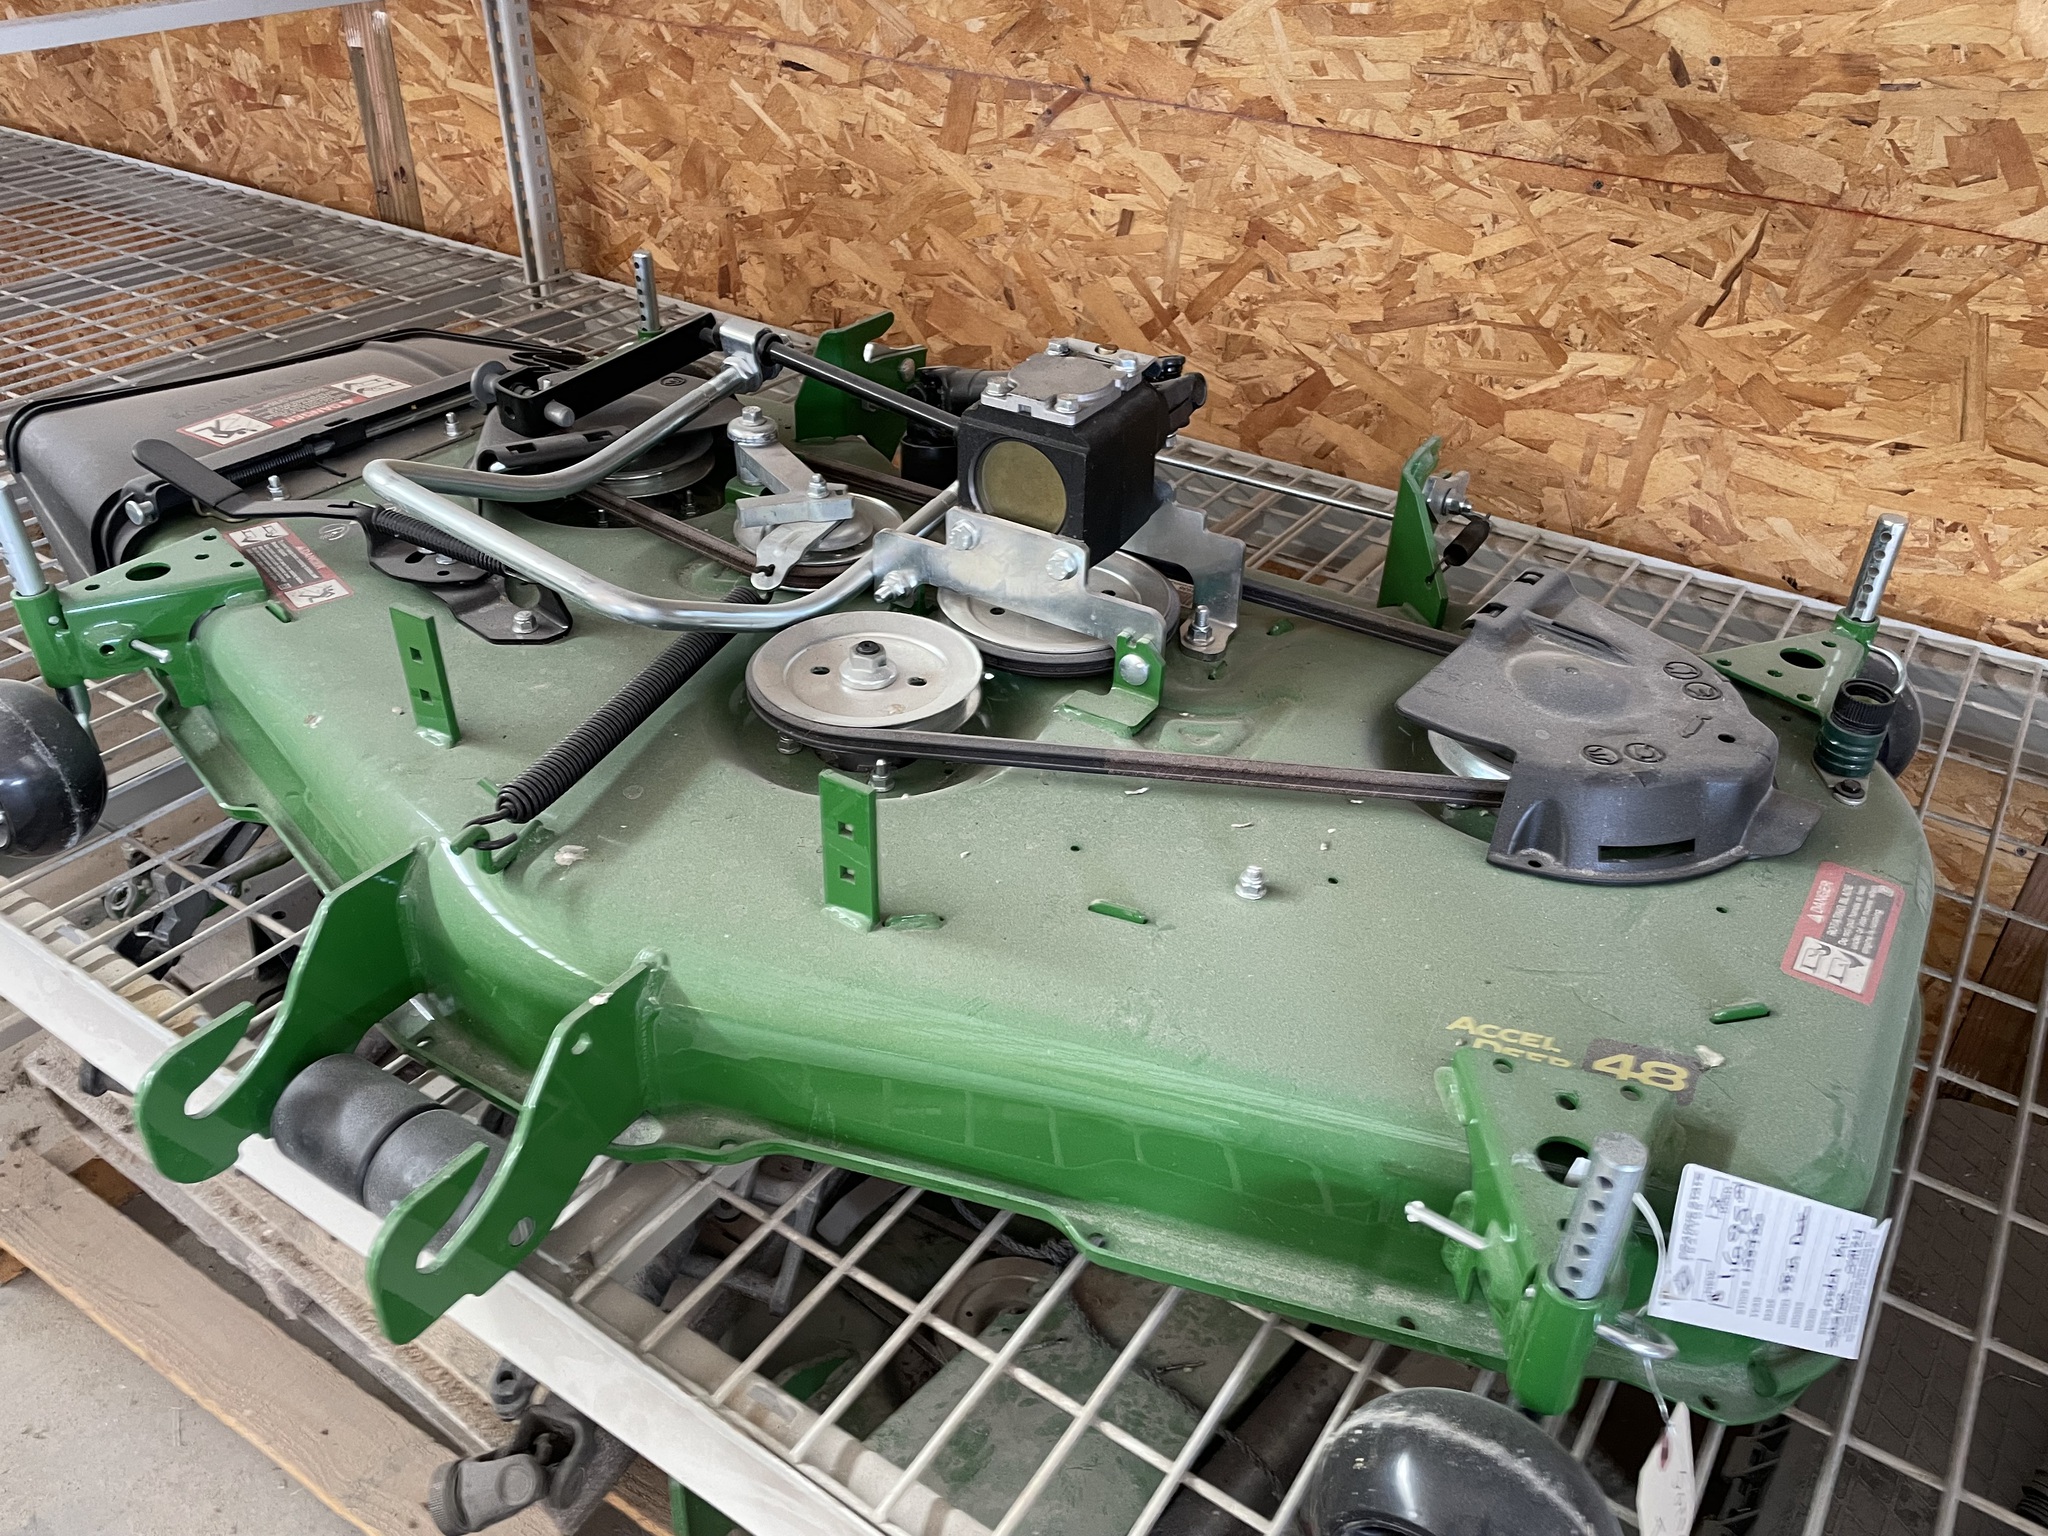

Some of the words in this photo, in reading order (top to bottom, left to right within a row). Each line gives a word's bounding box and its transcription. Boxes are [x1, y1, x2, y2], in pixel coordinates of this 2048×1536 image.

[281, 402, 342, 424] DANGER
[1809, 879, 1834, 914] DANGER
[1445, 1016, 1562, 1053] ACCEL
[1591, 1053, 1691, 1092] 48
